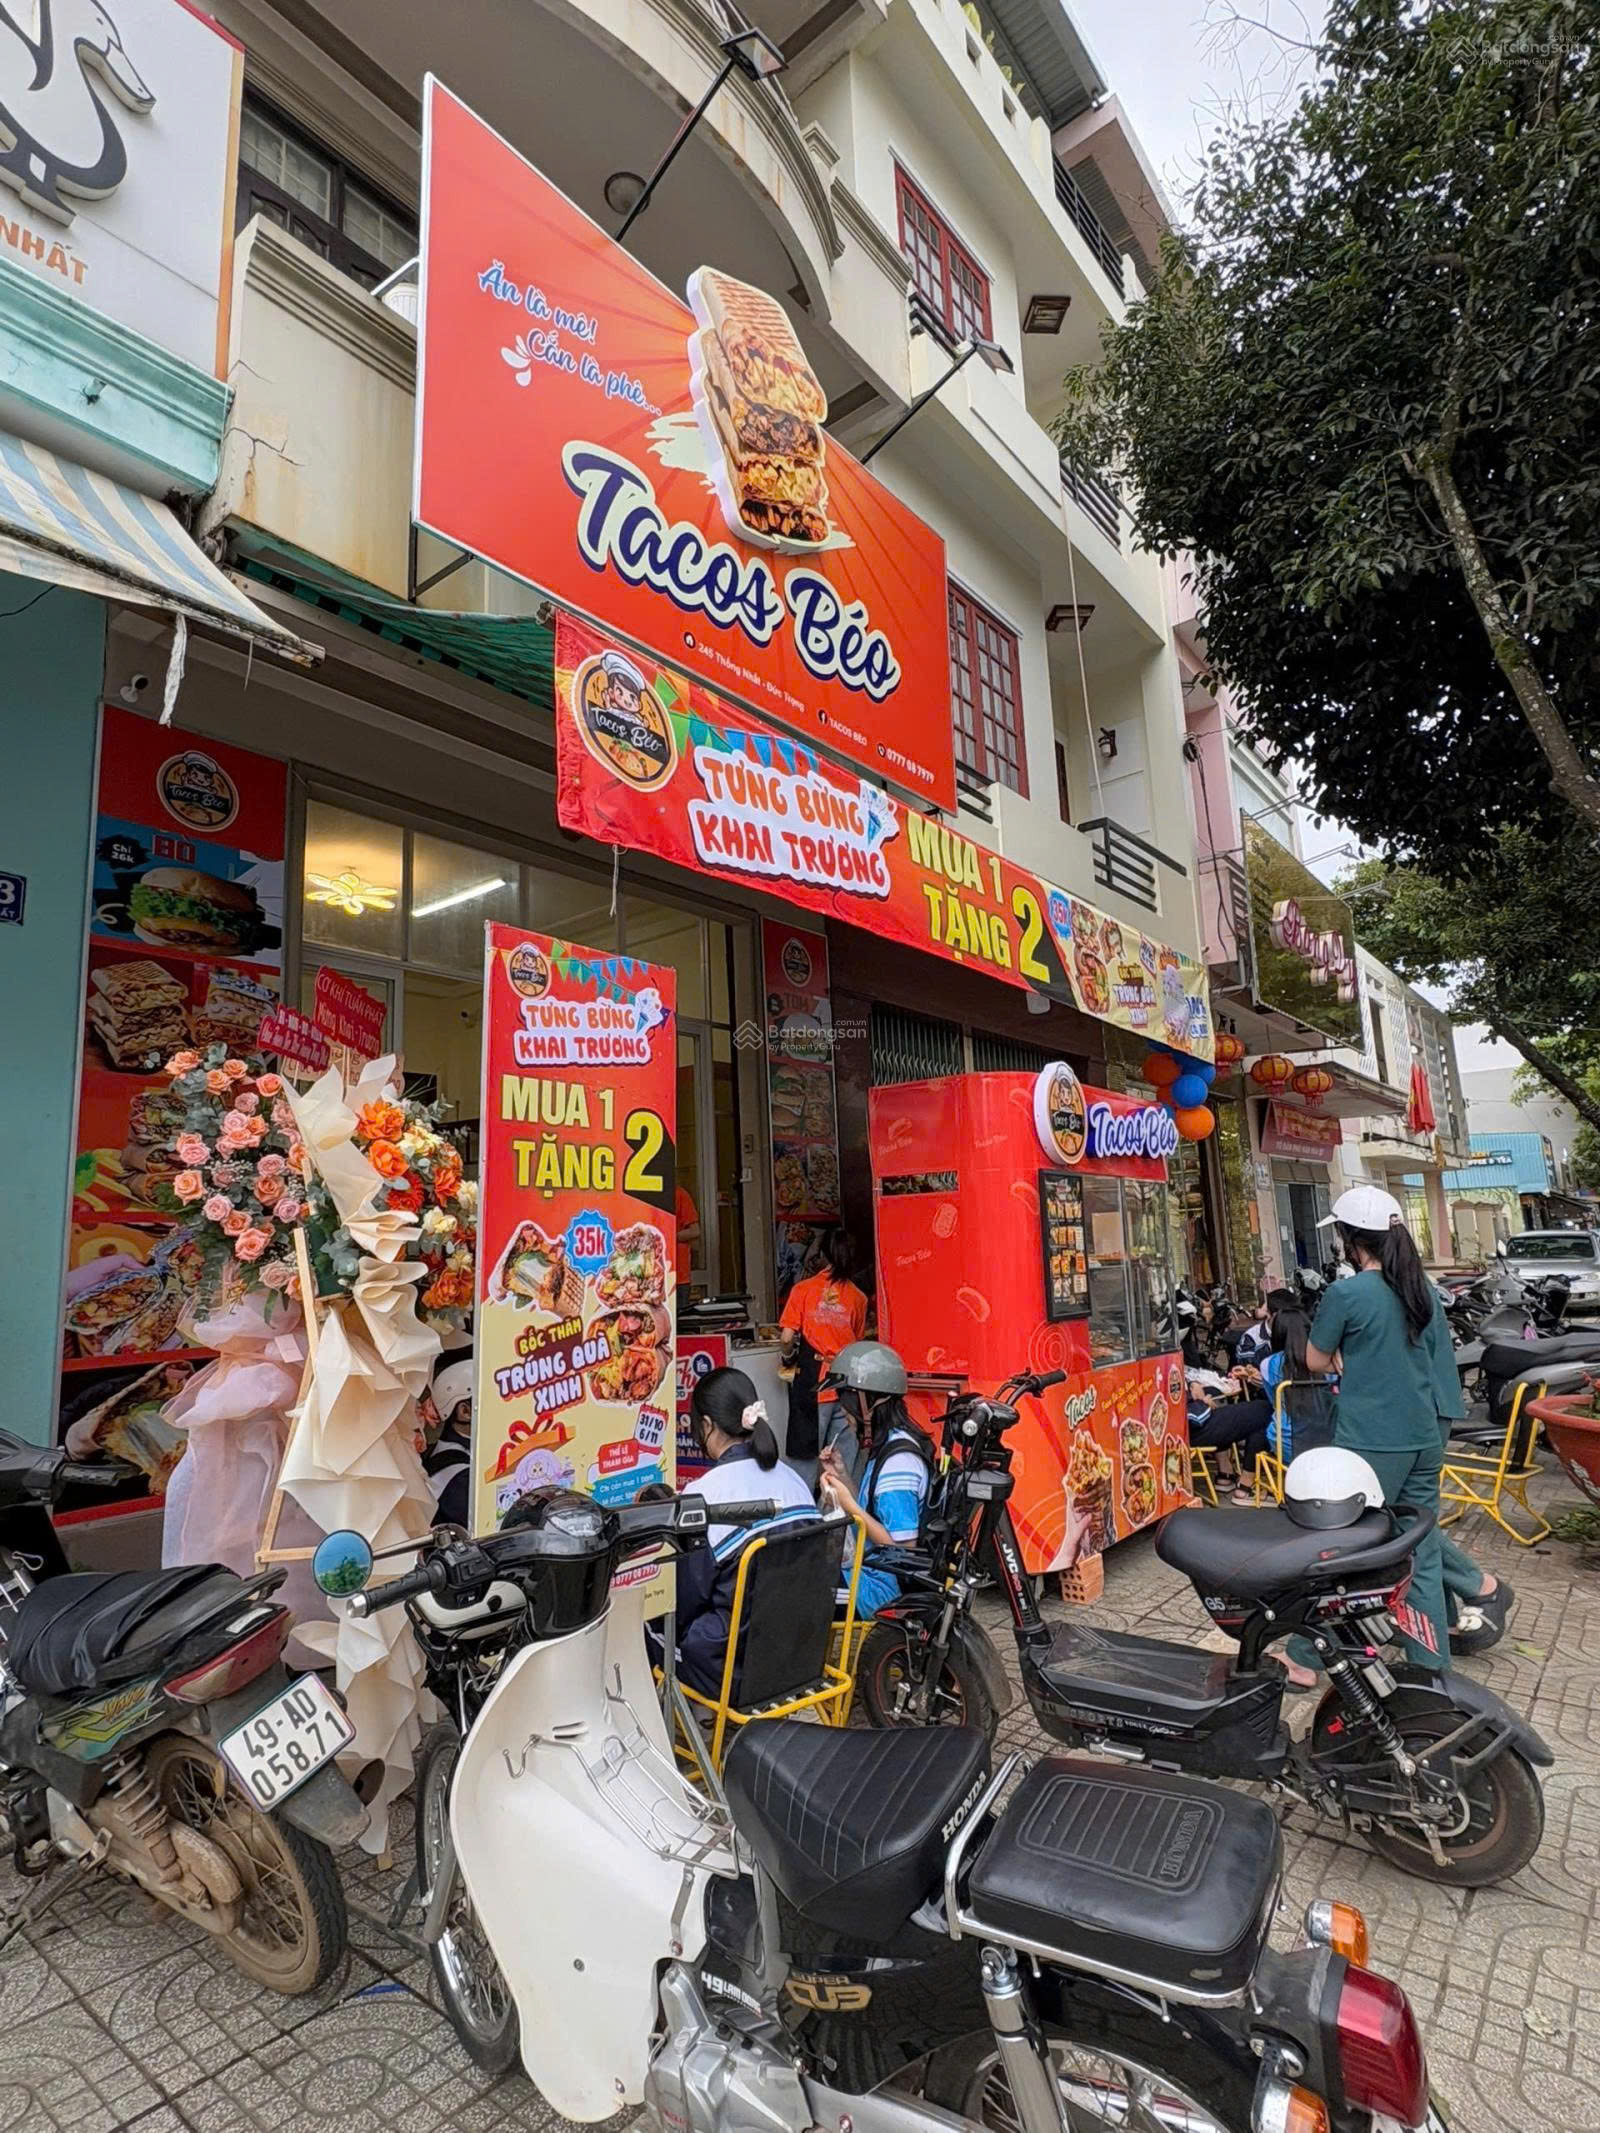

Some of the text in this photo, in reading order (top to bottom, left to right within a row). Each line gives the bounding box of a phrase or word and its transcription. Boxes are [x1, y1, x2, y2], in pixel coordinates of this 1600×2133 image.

[478, 259, 598, 345] Ăn là mê!
[528, 329, 577, 373] Cắn
[580, 353, 603, 386] là
[565, 443, 899, 698] Tacos Béo
[698, 643, 715, 660] 245
[590, 707, 629, 738] Tacos
[829, 718, 852, 739] TACOS
[702, 756, 865, 836] TƯNG BỪNG
[696, 810, 885, 888] KHAI TRƯƠNG
[907, 810, 1004, 905] MUA 1
[923, 883, 1012, 970] TẶNG
[1012, 886, 1051, 984] 2
[526, 1000, 636, 1030] TƯNG BỪNG
[519, 1033, 648, 1059] KHAI TRƯƠNG
[501, 1074, 614, 1131] MUA 1
[1090, 1102, 1179, 1159] Tacos Béo
[513, 1111, 664, 1198] TẶNG 2
[575, 1226, 606, 1257] 35k
[496, 1331, 610, 1395] TRÚNG QUÀ
[519, 1329, 546, 1355] BỐC
[535, 1374, 582, 1413] XINH
[639, 1429, 659, 1445] 6/11
[640, 1413, 664, 1432] 31/10
[1002, 1543, 1019, 1574] JVC
[243, 1688, 318, 1759] 49-AD
[251, 1711, 346, 1801] 058.71
[941, 1770, 987, 1844] HONDA
[1160, 1809, 1205, 1878] HONDA
[701, 1971, 723, 1995] 49
